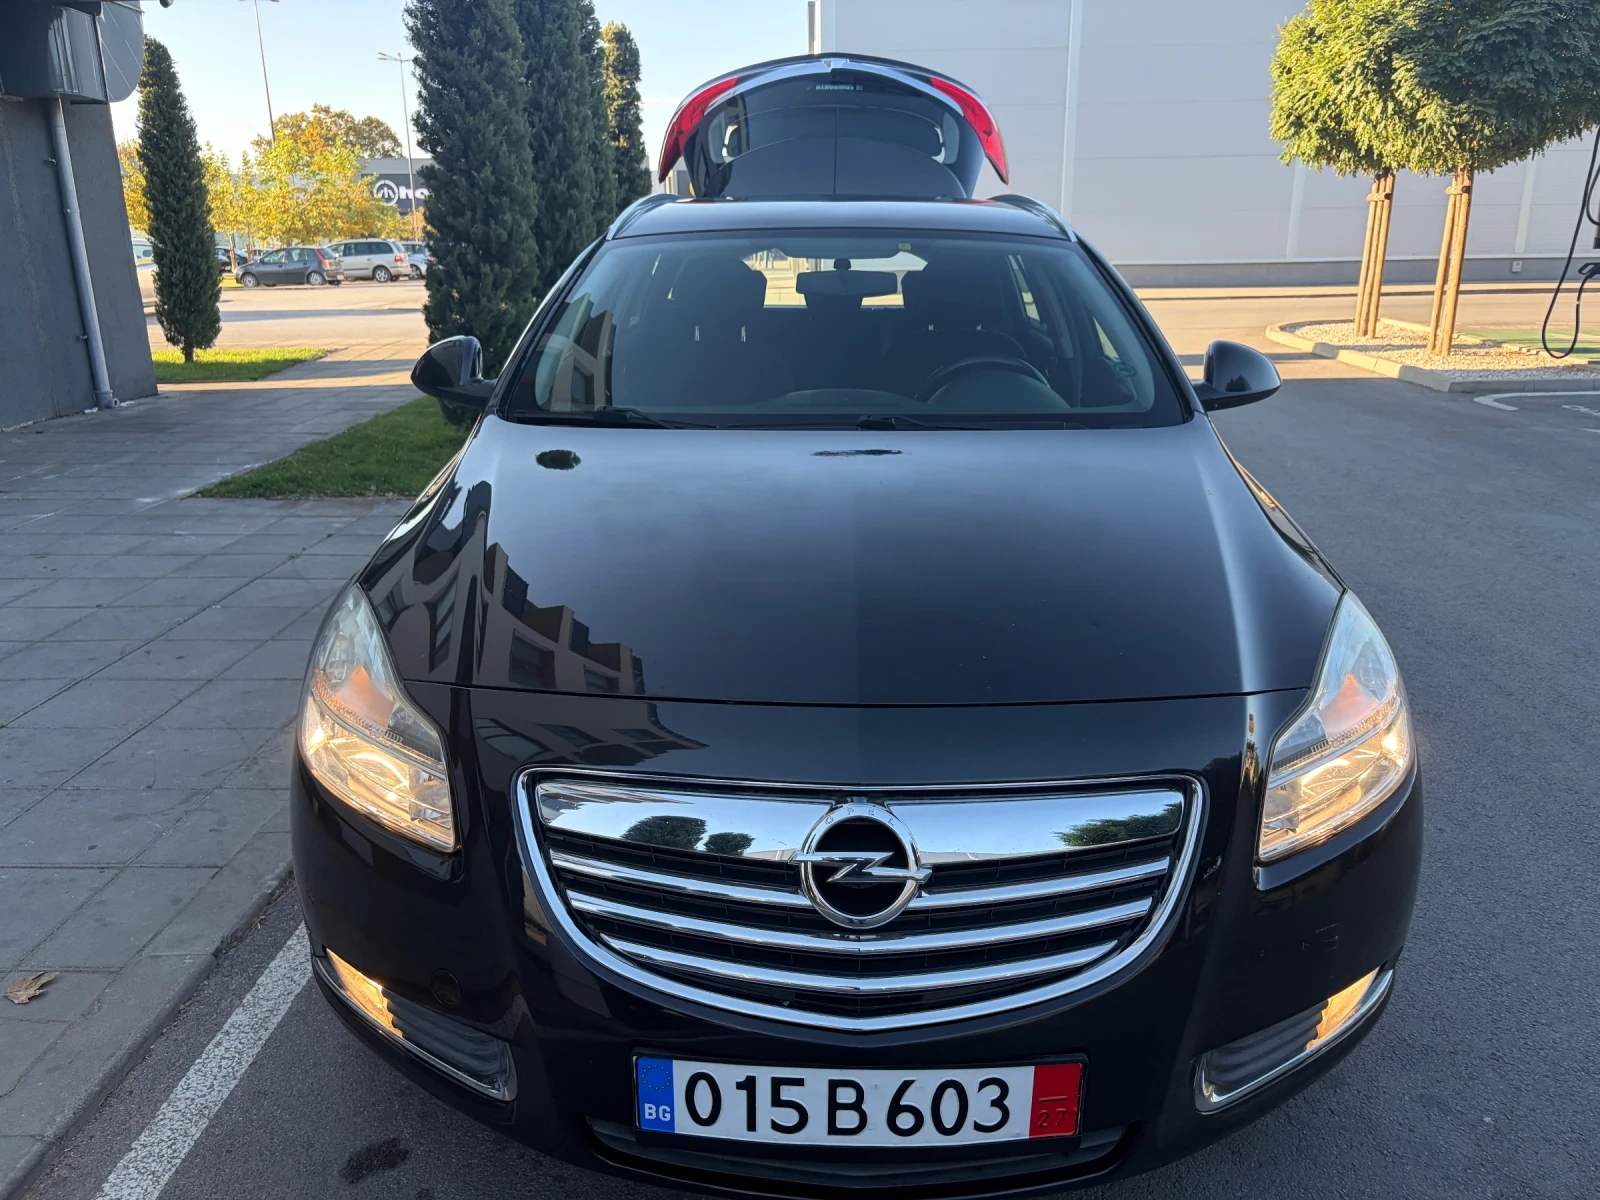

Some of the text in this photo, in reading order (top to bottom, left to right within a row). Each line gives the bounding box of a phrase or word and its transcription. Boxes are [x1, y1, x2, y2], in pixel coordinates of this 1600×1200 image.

[825, 808, 894, 826] OPEL
[644, 1103, 671, 1121] BG
[1038, 1107, 1067, 1128] 27
